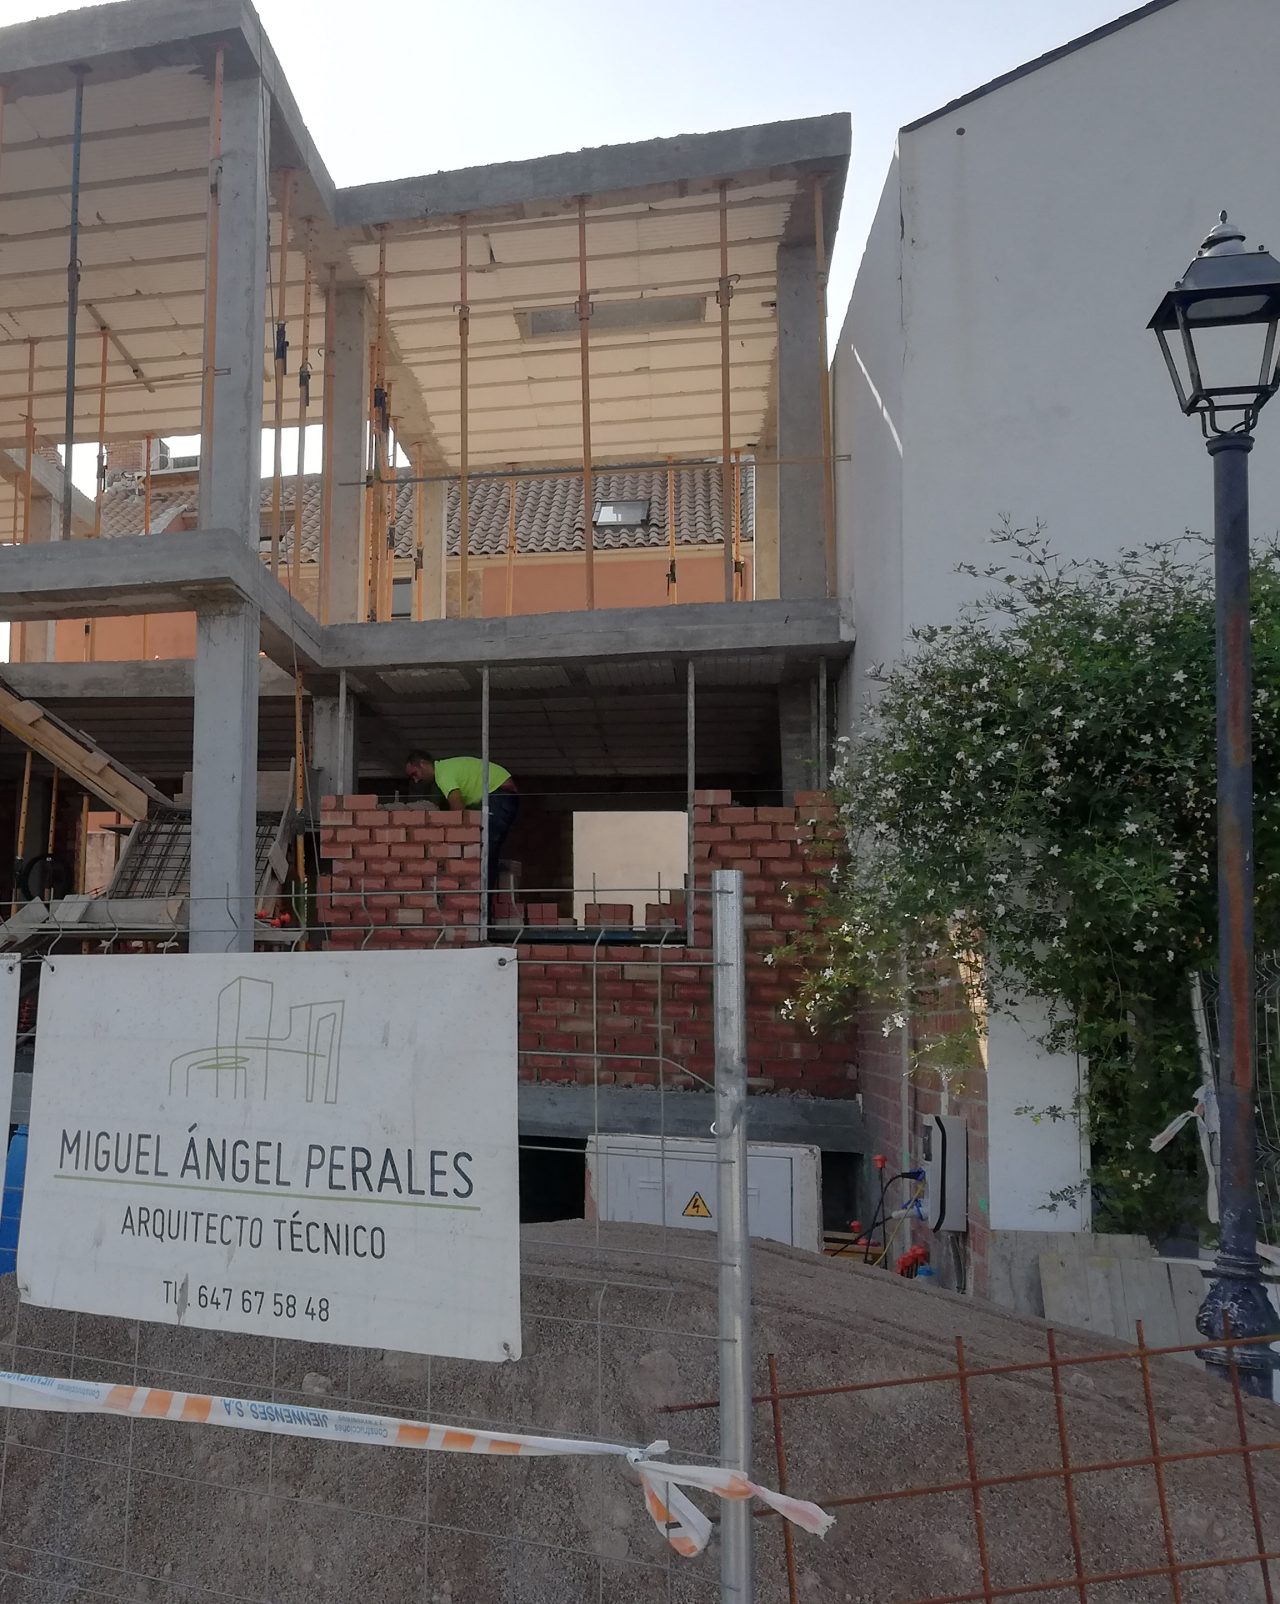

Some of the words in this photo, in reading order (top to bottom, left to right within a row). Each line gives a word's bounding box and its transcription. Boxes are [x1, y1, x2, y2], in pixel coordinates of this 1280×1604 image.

[59, 1129, 169, 1177] MIGUEL
[180, 1122, 291, 1187] ÁNGEL
[305, 1144, 474, 1199] PERALES
[121, 1205, 263, 1249] ARQUITECTO
[273, 1210, 386, 1259] TÉCNICO
[198, 1285, 233, 1311] 647
[241, 1289, 265, 1315] 67
[273, 1293, 297, 1318] 58
[304, 1296, 330, 1322] 48
[334, 1423, 388, 1439] Construcciones
